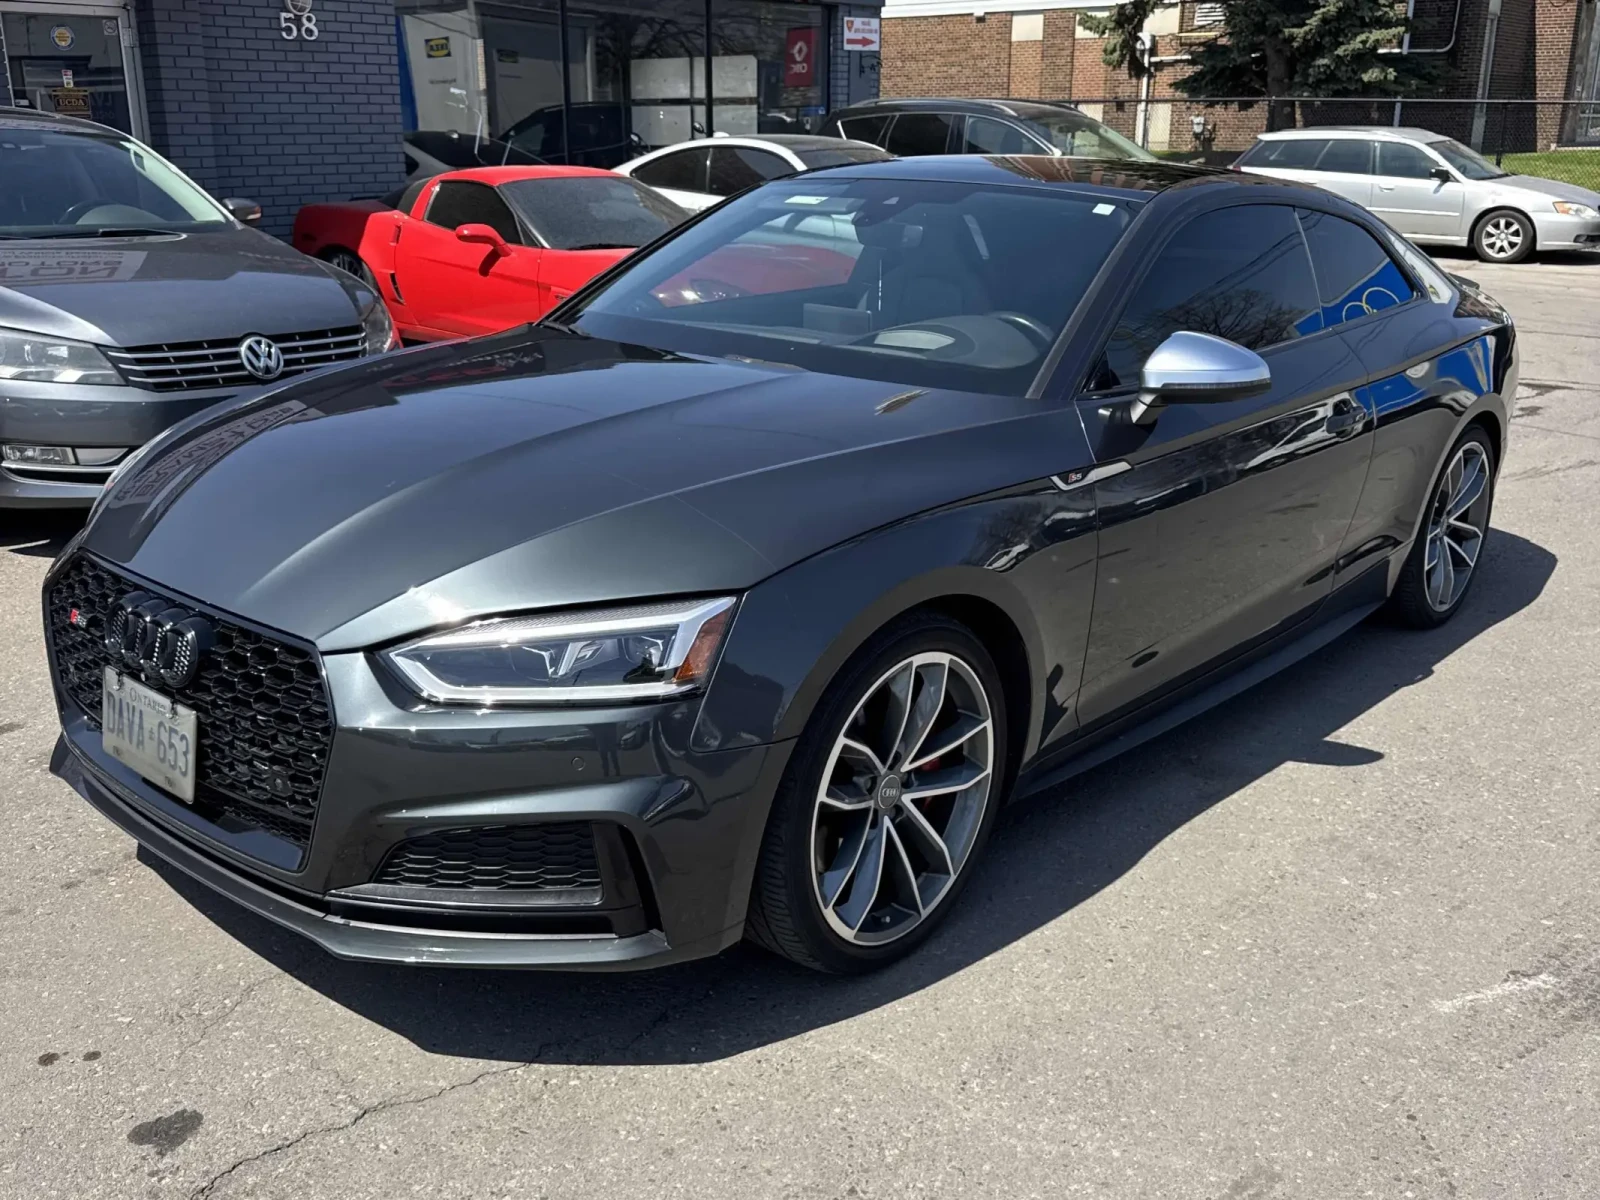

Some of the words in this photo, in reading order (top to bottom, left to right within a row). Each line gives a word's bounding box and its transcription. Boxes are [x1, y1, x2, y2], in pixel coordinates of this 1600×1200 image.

[279, 12, 319, 40] 58
[59, 98, 86, 106] UCDA
[107, 690, 145, 752] DAVA
[157, 720, 189, 777] 653
